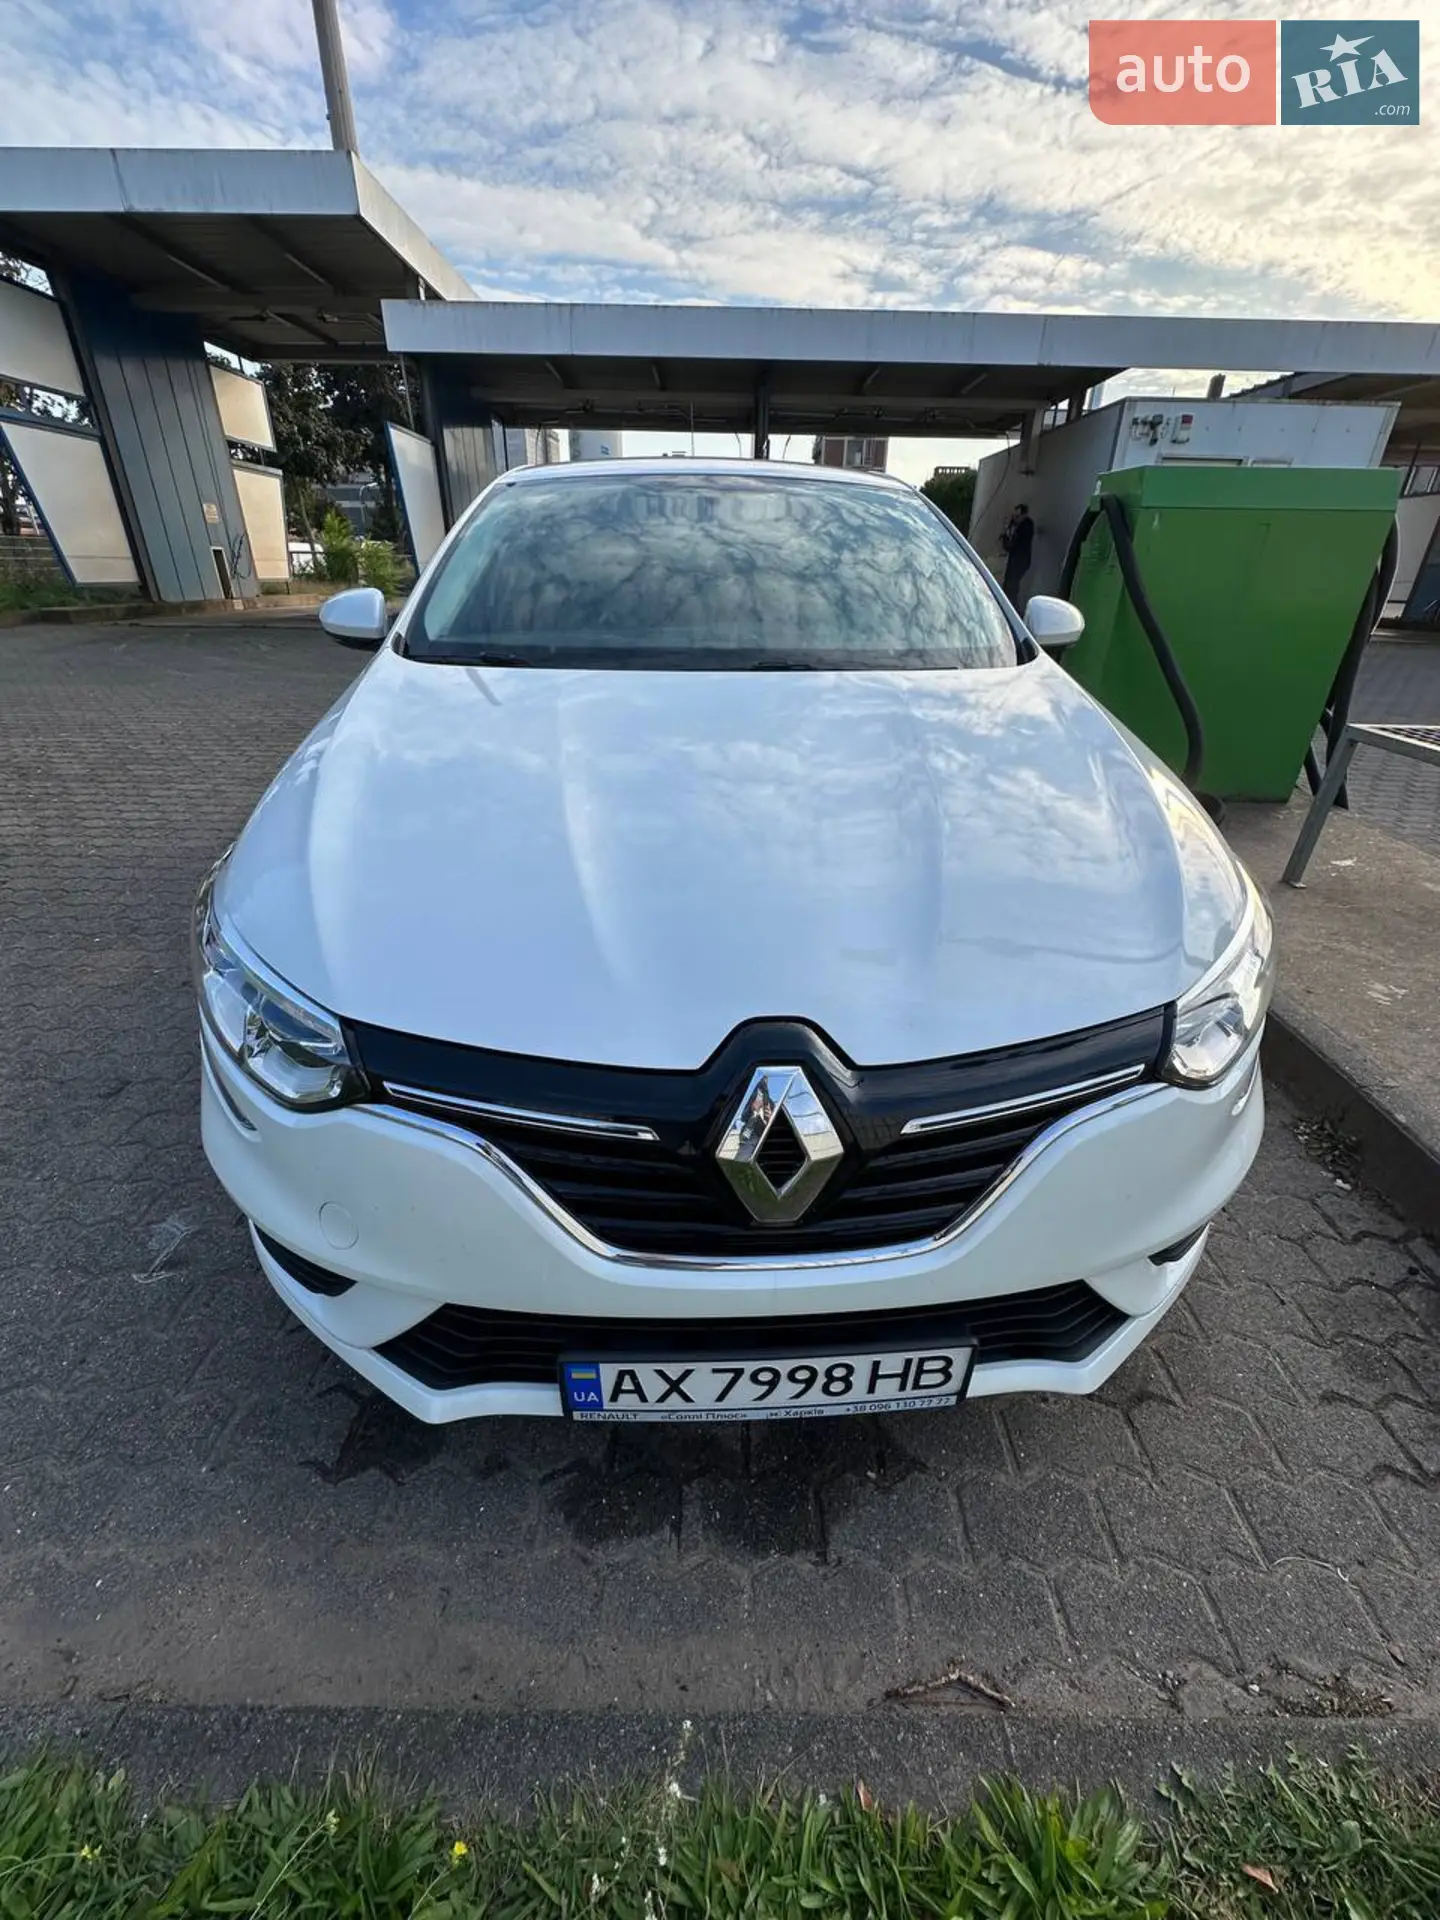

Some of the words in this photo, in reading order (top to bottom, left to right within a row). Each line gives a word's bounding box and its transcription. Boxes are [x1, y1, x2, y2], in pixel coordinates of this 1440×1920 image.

[608, 1368, 696, 1404] AX
[711, 1362, 856, 1403] 7998
[866, 1355, 954, 1394] HB
[573, 1391, 600, 1402] UA
[579, 1412, 639, 1421] RENAULT
